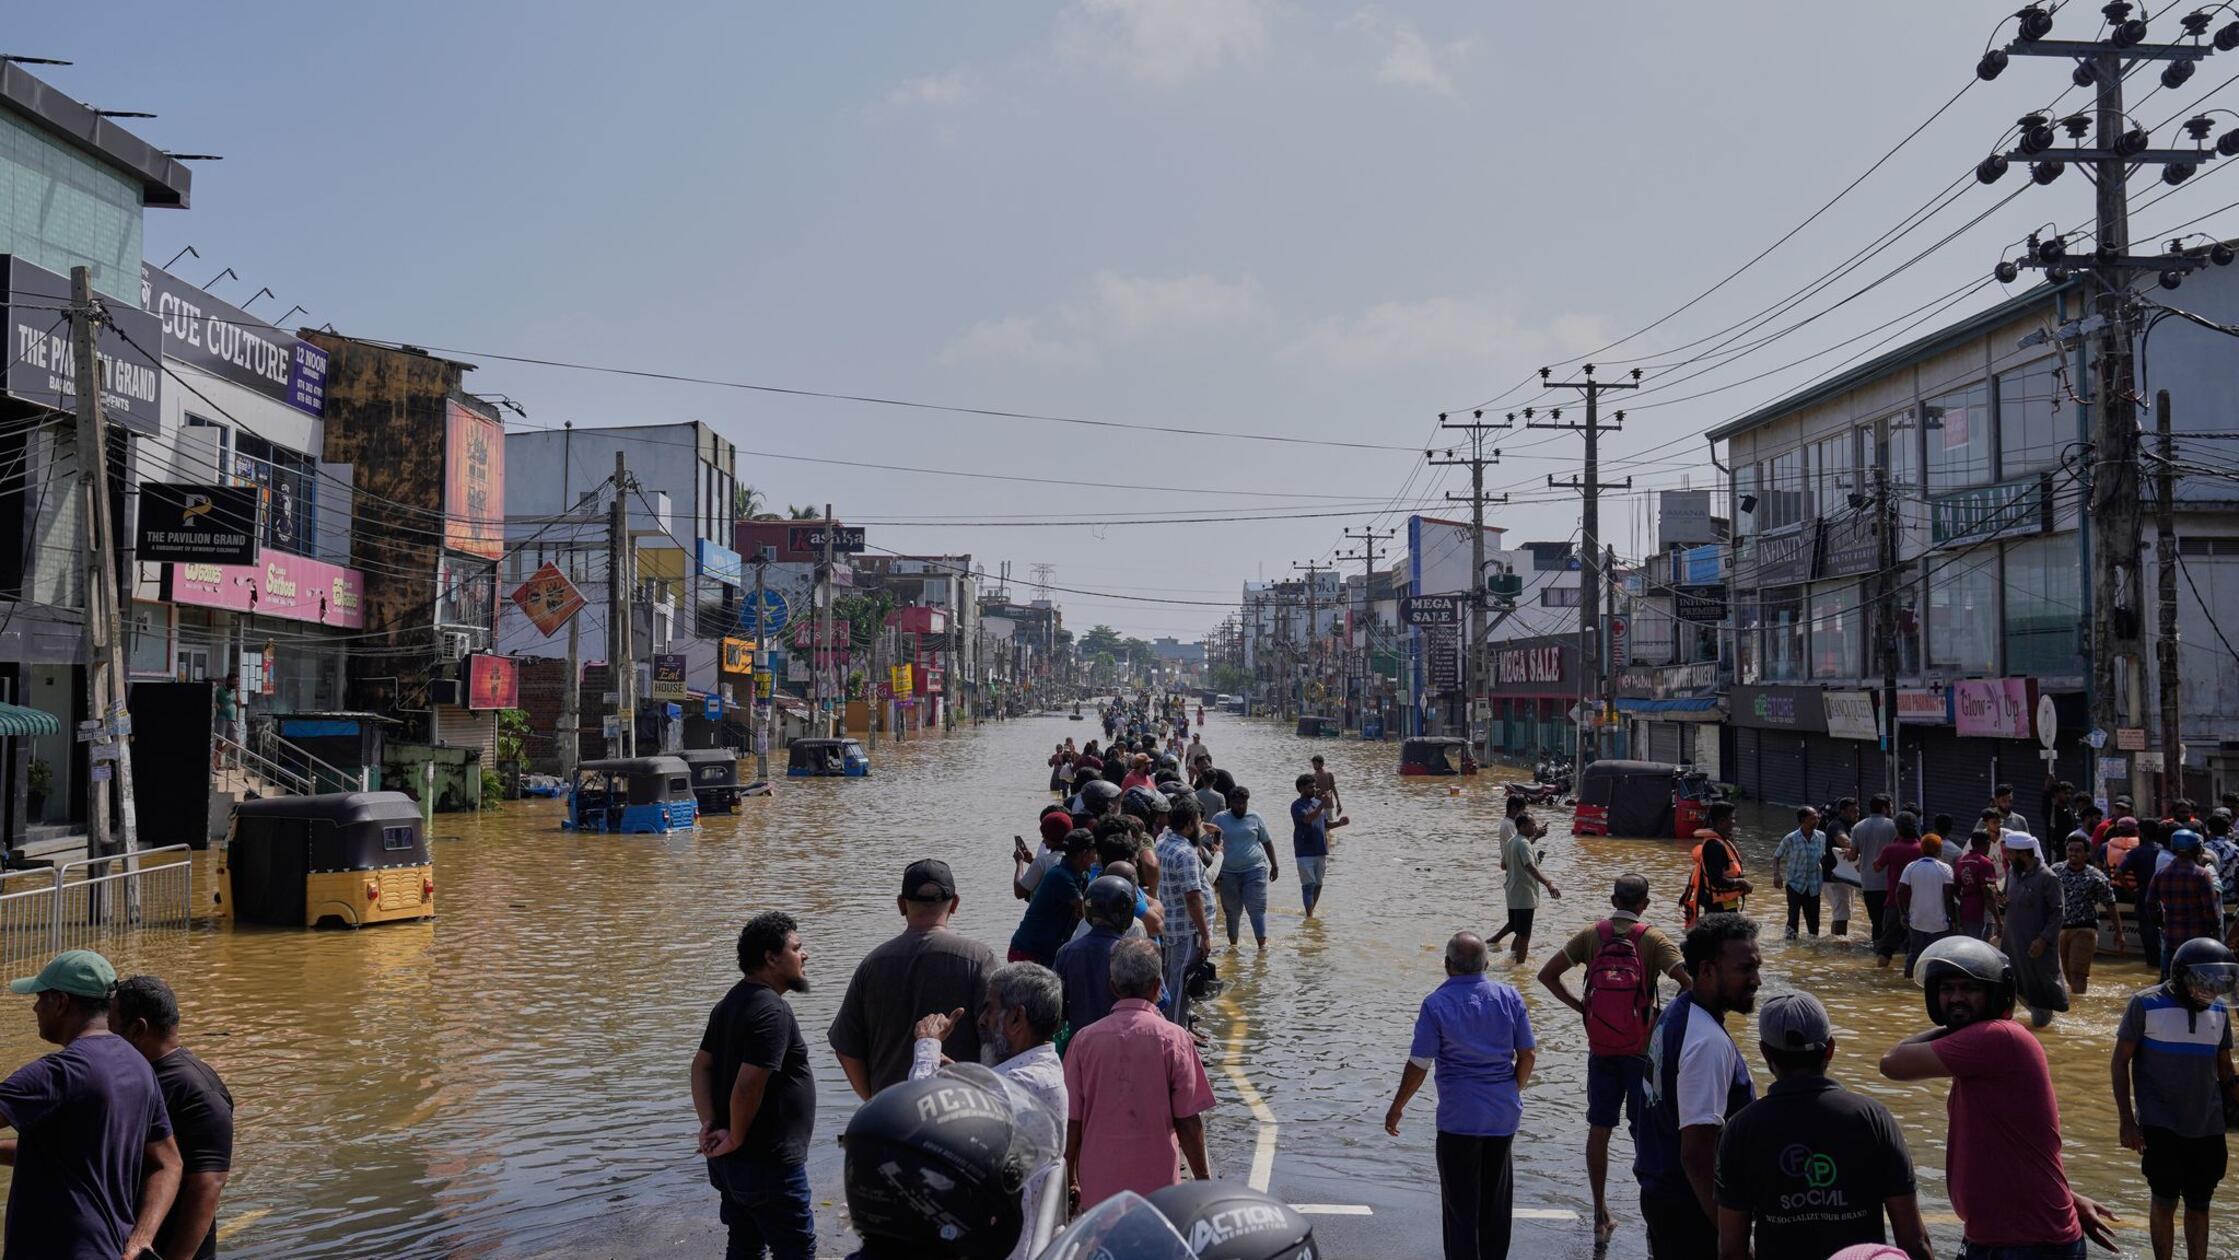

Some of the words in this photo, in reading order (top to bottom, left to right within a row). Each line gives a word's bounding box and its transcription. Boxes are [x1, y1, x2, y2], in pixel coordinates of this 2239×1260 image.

[160, 291, 200, 347] CUE
[207, 315, 289, 386] CULTURE
[18, 323, 48, 369] THE
[115, 358, 156, 402] GRAND
[296, 346, 305, 364] 12
[305, 350, 327, 375] NOON
[1940, 484, 2032, 541] MADAME
[147, 531, 165, 542] THE
[168, 532, 211, 544] PAVILION
[213, 534, 246, 545] GRAND
[1760, 535, 1803, 566] INFINITY
[1411, 599, 1452, 608] MEGA
[1412, 611, 1450, 622] SALE
[1500, 651, 1527, 683] MEGA
[1529, 647, 1560, 682] SALE
[655, 682, 683, 694] HOUSE
[1961, 690, 1985, 717] Glow
[2004, 695, 2019, 723] Up
[1814, 1162, 1829, 1181] P
[1780, 1189, 1848, 1210] SOCIAL
[1186, 1206, 1287, 1257] ACTION
[1222, 1223, 1288, 1242] GENERATION
